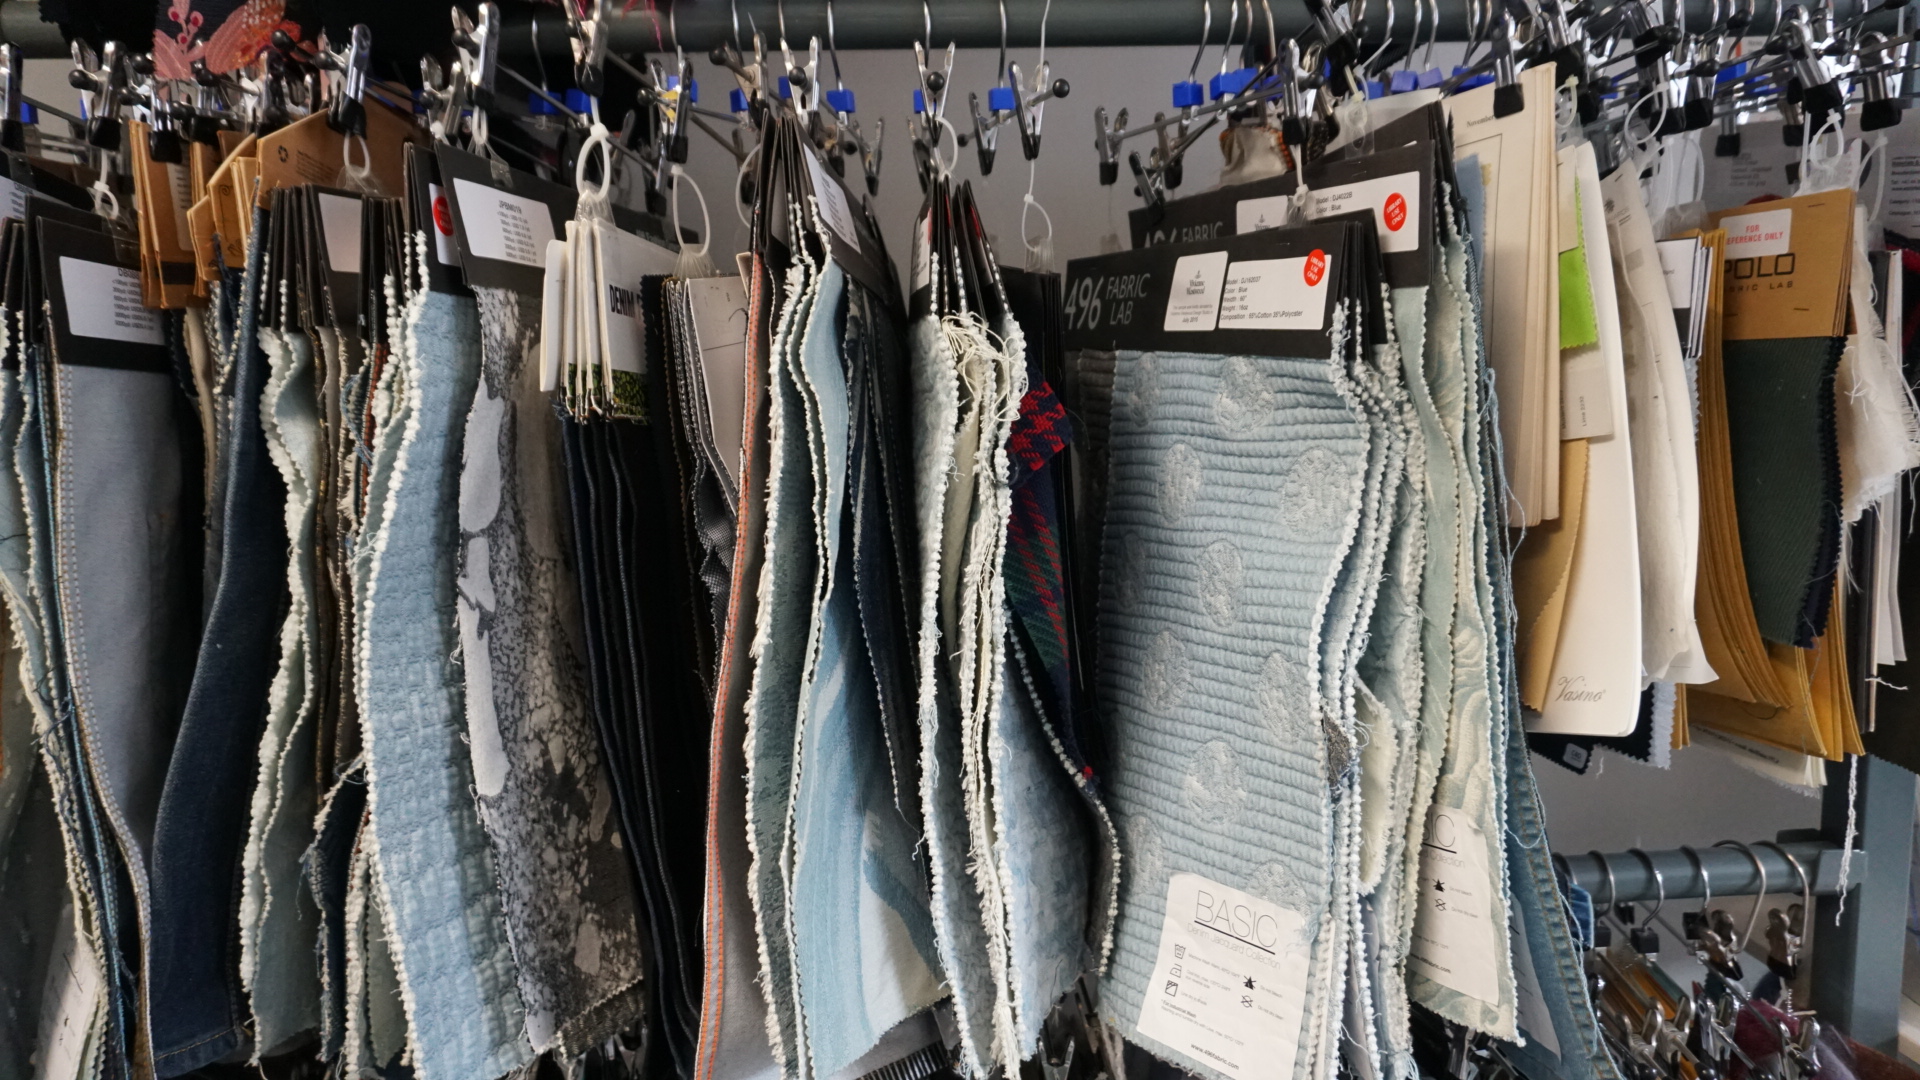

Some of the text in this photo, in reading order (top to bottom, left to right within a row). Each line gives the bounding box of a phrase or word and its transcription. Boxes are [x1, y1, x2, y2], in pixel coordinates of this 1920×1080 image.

[1387, 198, 1402, 213] LIBRARY
[1391, 206, 1400, 217] USE
[1391, 212, 1404, 225] ONLY
[1746, 224, 1760, 233] FOR
[1726, 231, 1784, 245] EFERENCE ONLY
[1310, 256, 1325, 269] LIBRARY
[1311, 264, 1319, 274] USE
[1306, 270, 1318, 281] ONLY
[1728, 281, 1794, 293] BRIC LAB
[609, 284, 635, 319] DENIM
[1064, 273, 1150, 331] 496 FABRIC
[1110, 301, 1133, 325] LAB
[1195, 890, 1278, 948] BASIC
[1187, 922, 1281, 970] Denim Jacquard Collection
[1190, 1043, 1239, 1070] www.496fabric.com
